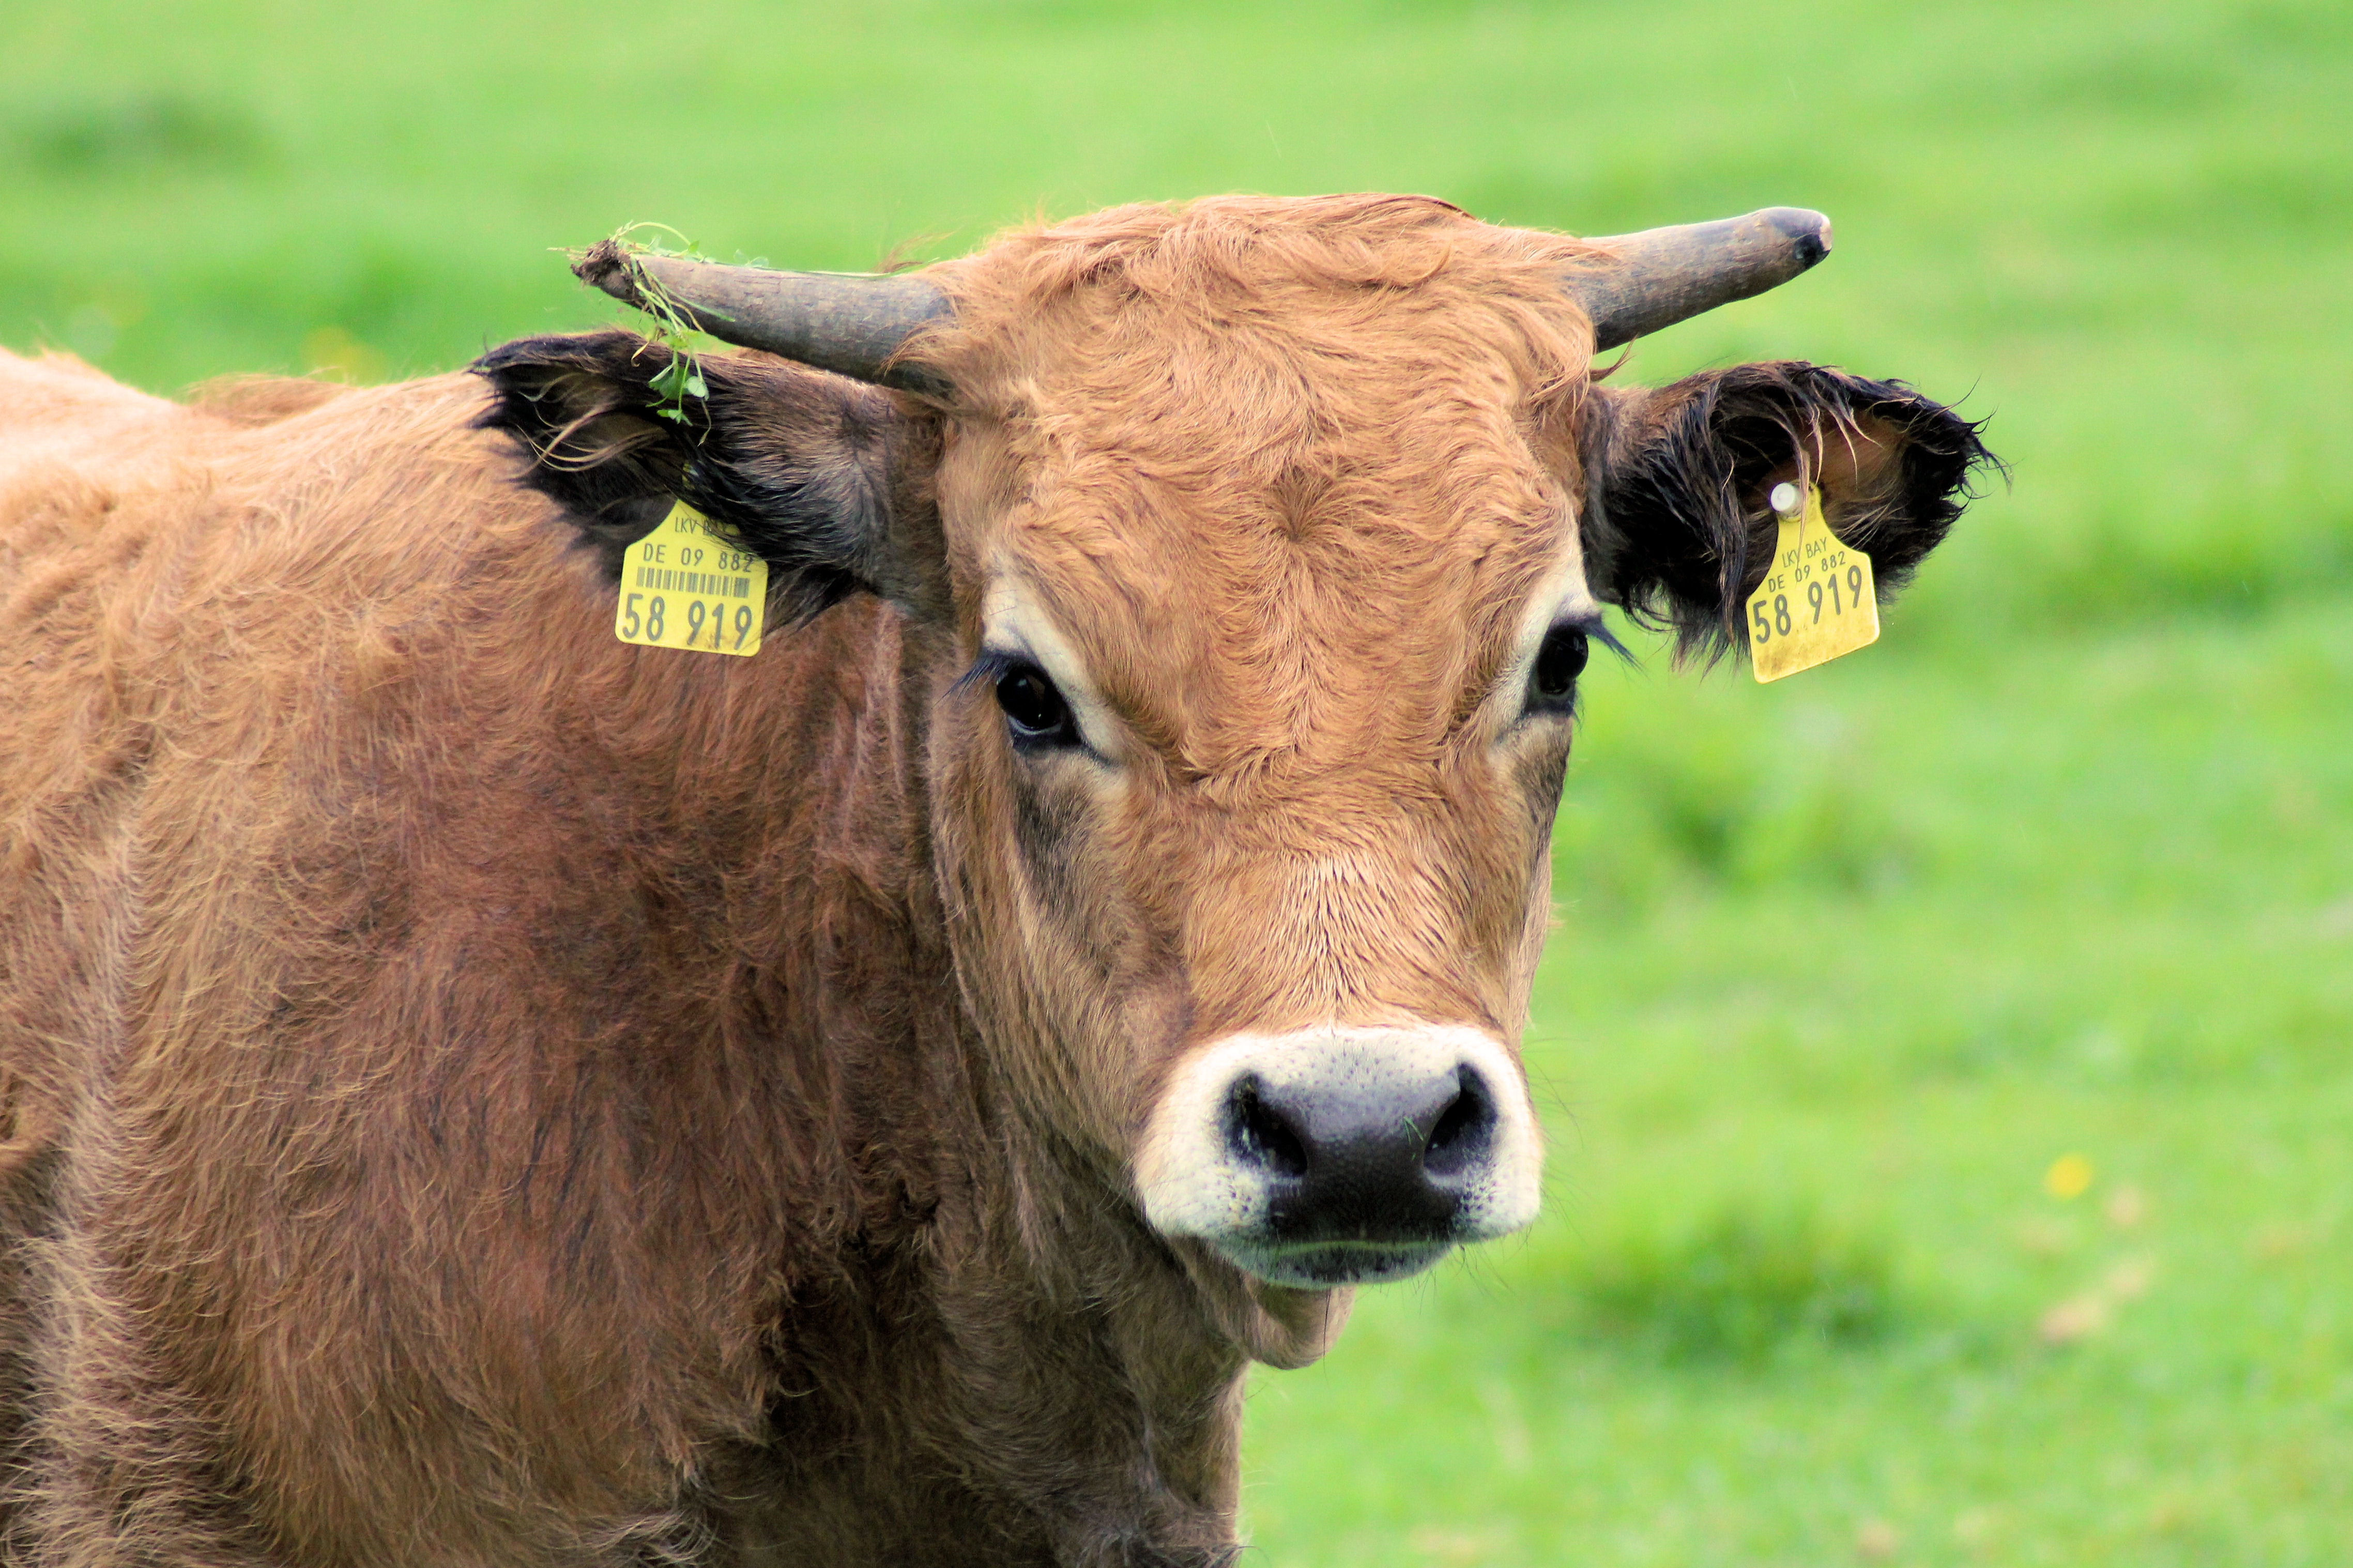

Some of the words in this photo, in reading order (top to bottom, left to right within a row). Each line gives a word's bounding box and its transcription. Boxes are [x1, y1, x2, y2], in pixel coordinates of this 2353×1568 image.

[675, 517, 697, 534] LKV
[643, 543, 666, 563] DE
[681, 547, 704, 566] 09
[719, 551, 754, 572] 882
[1806, 537, 1827, 558] BAY
[1768, 574, 1785, 592] DE
[1795, 565, 1811, 582] 09
[1821, 551, 1846, 572] 882
[622, 593, 665, 641] 58
[686, 601, 753, 650] 919
[1753, 594, 1792, 644] 58
[1808, 565, 1862, 625] 919
